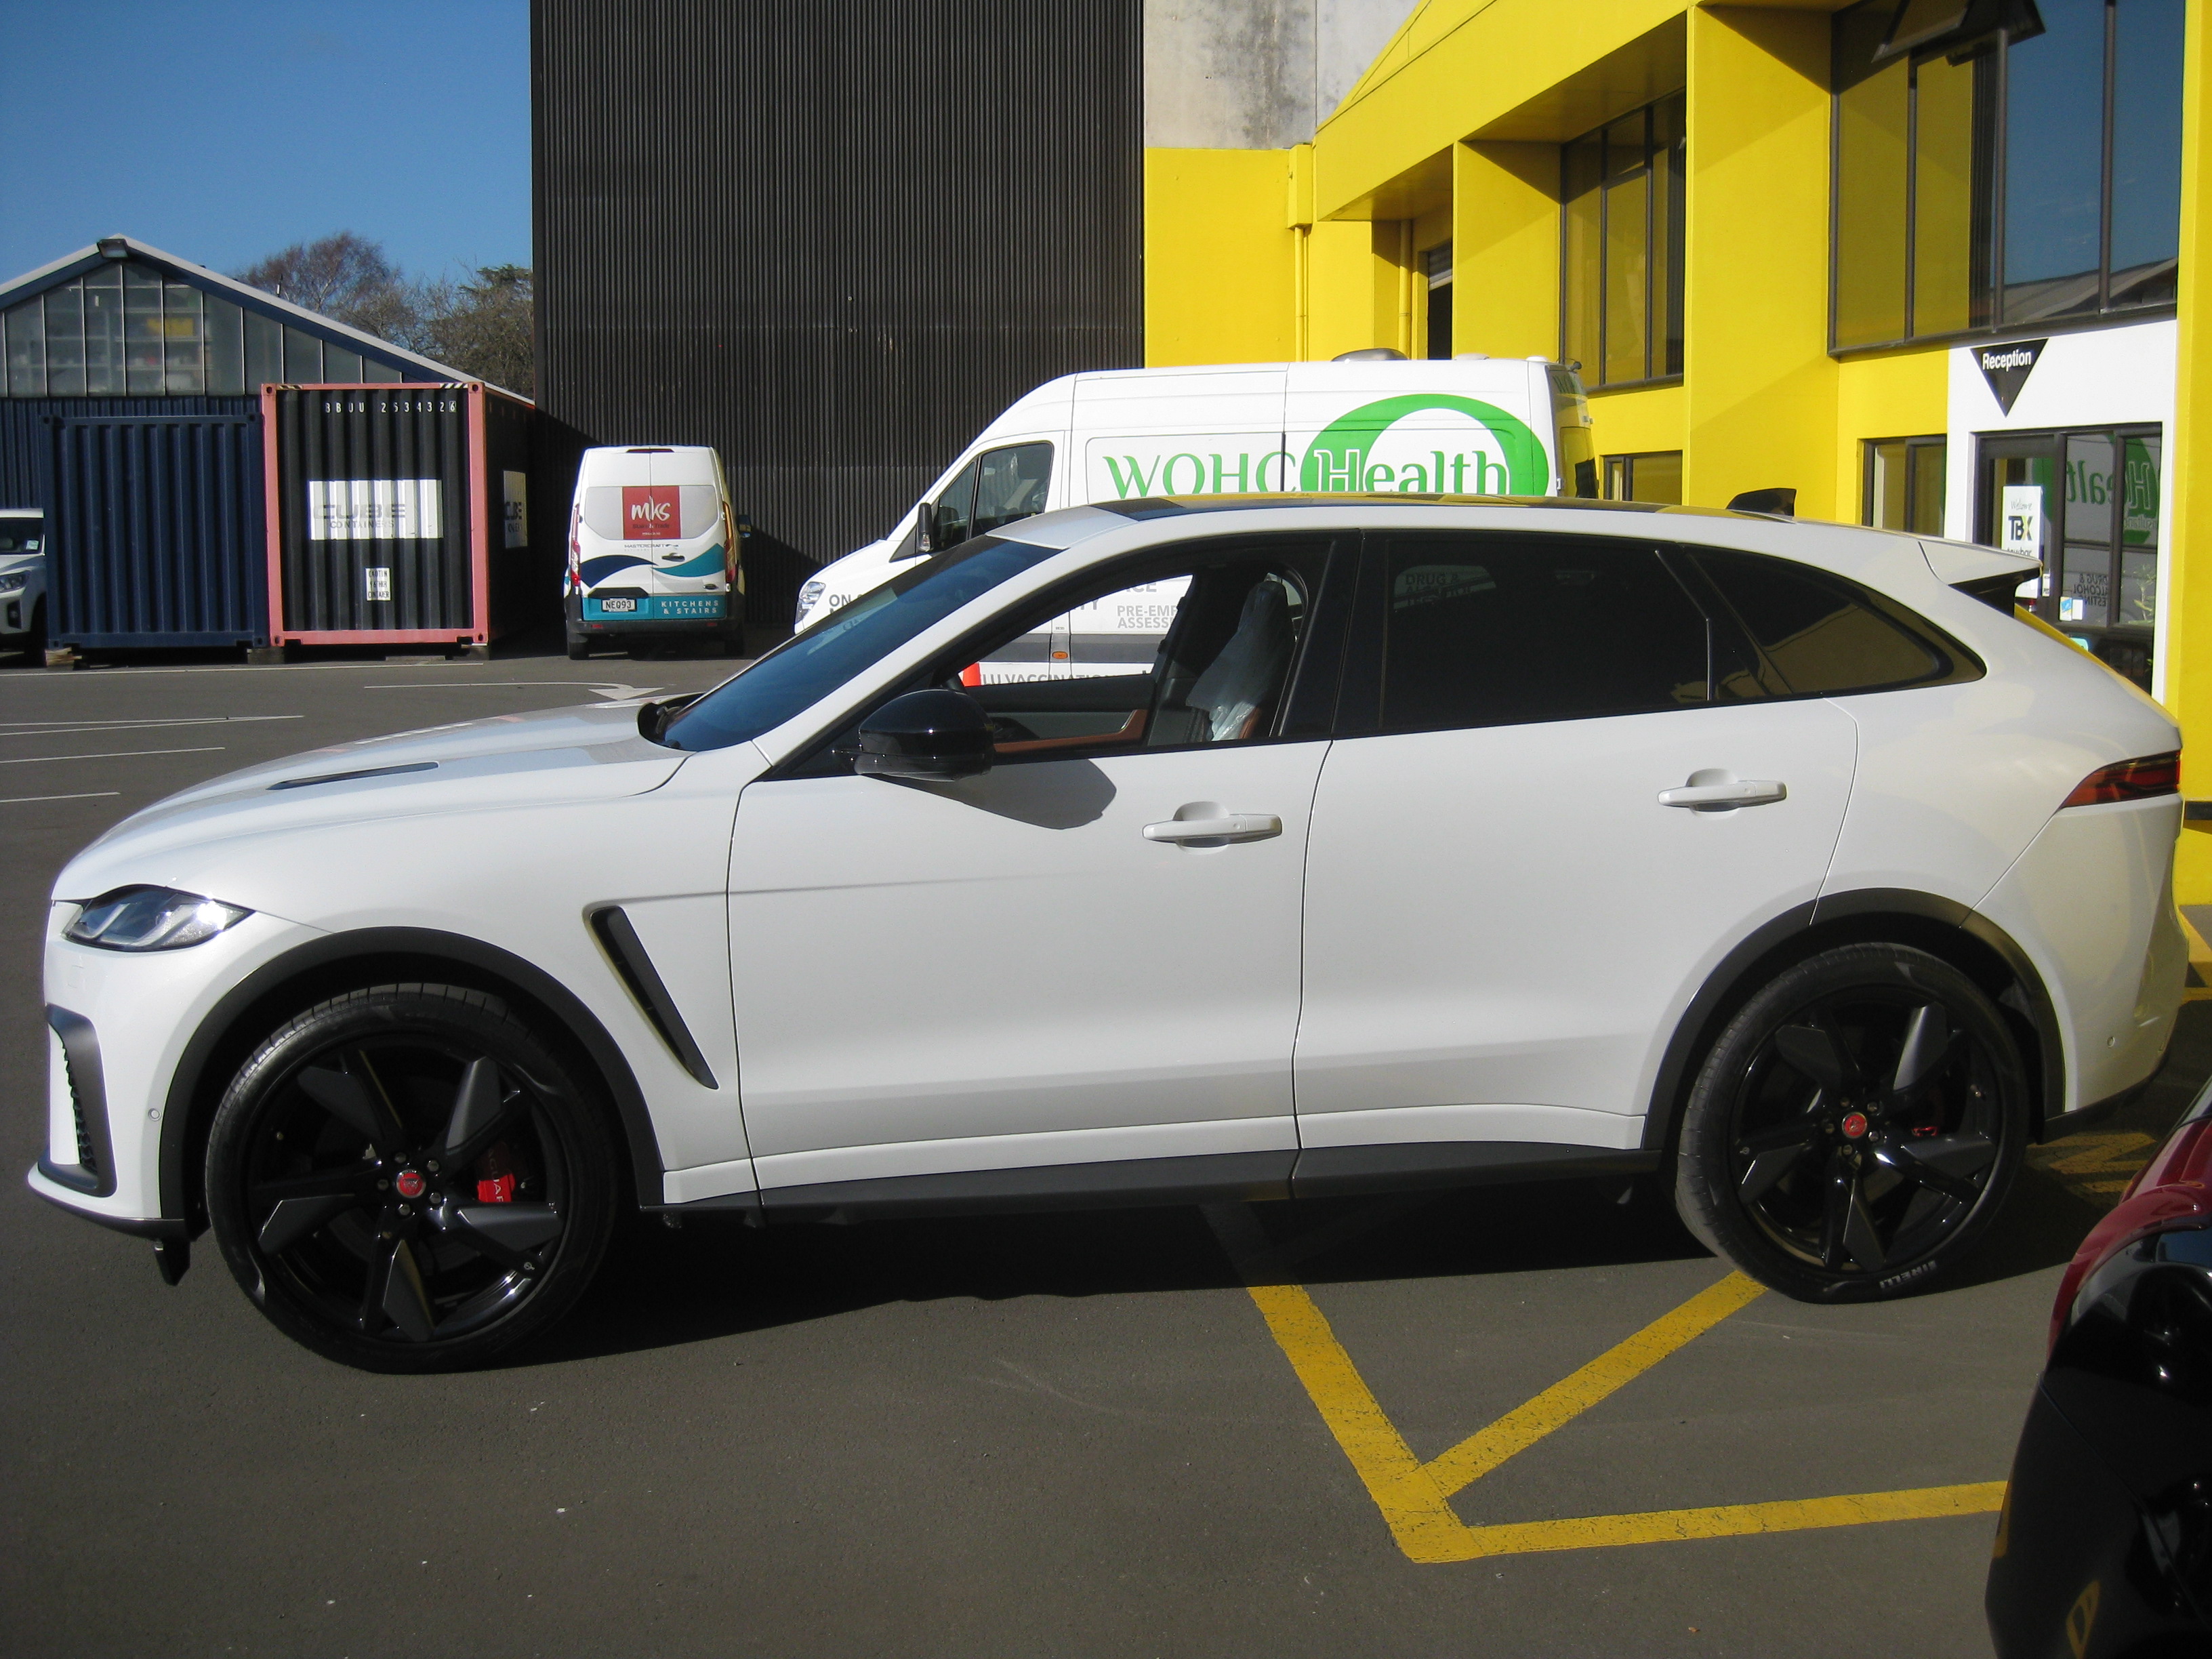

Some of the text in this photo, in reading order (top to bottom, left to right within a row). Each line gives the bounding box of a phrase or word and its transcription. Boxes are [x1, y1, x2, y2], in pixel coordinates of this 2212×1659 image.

[1982, 348, 2032, 373] Reception
[1102, 449, 1510, 500] WOHC Health
[313, 504, 406, 519] CUBE
[631, 495, 671, 522] mks
[2007, 515, 2034, 541] TBX
[1117, 617, 1175, 629] ASSESS
